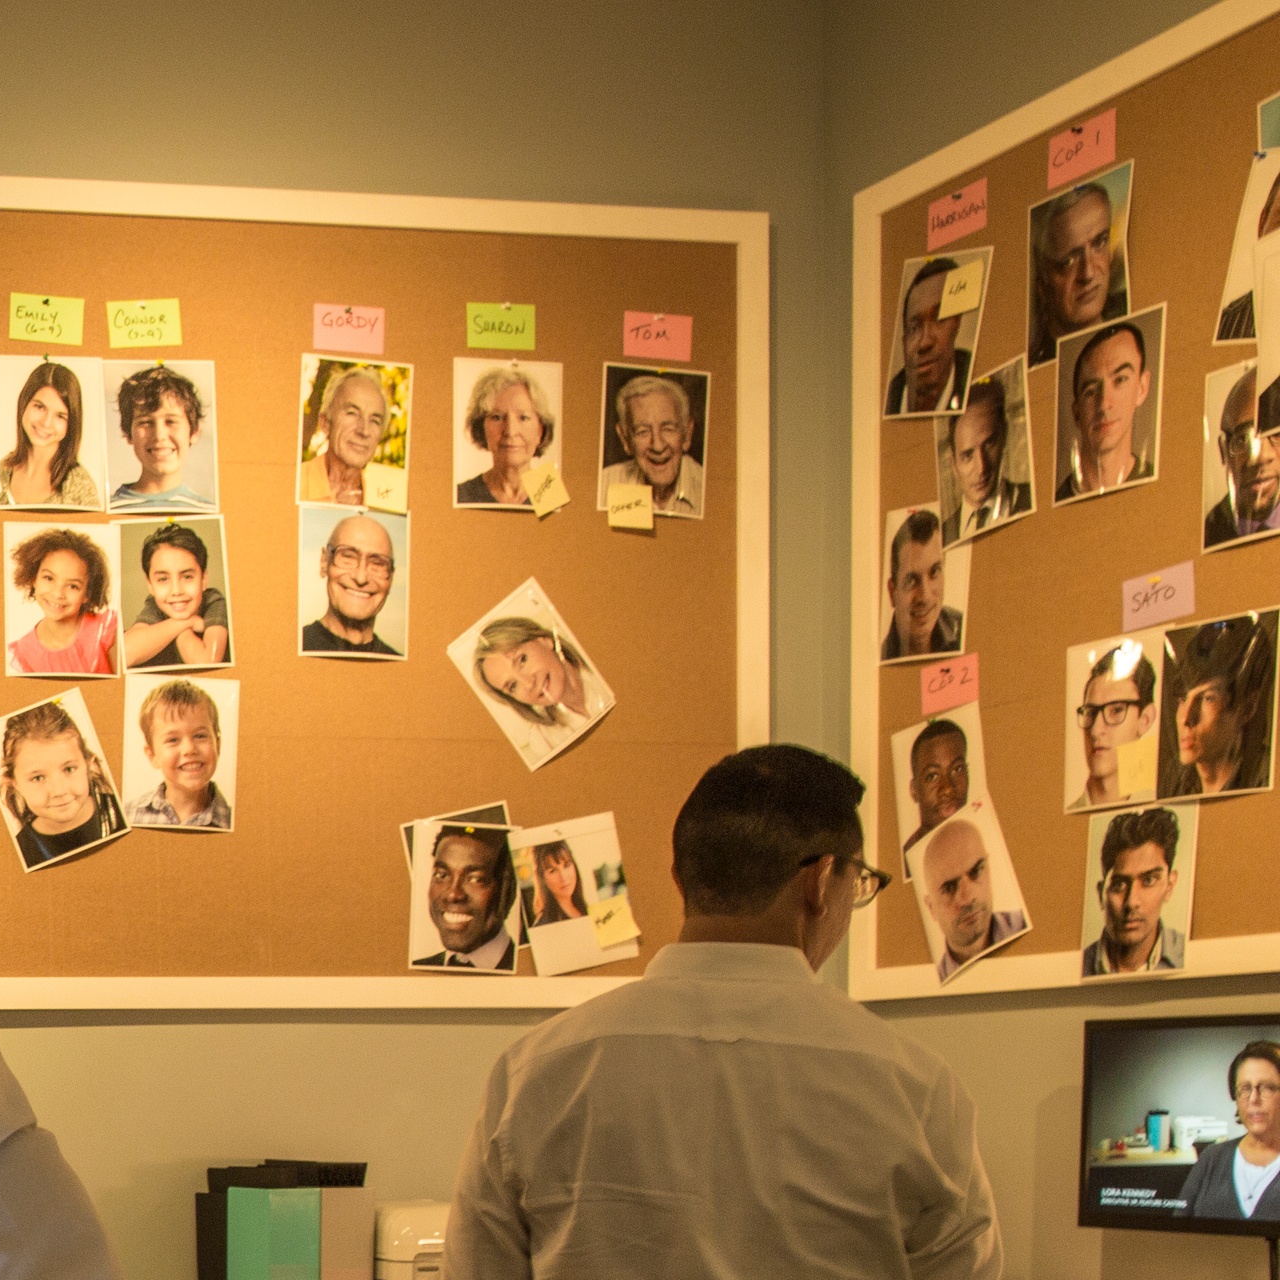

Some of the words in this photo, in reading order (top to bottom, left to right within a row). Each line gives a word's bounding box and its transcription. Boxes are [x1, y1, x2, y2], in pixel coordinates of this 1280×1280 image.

[1051, 144, 1085, 168] COP
[15, 304, 59, 323] EMILY
[113, 308, 167, 330] CONNOR
[320, 309, 380, 330] GORDY
[472, 314, 527, 336] SHARON
[629, 323, 672, 342] TOM
[1129, 584, 1177, 613] SATO
[959, 665, 974, 685] 2
